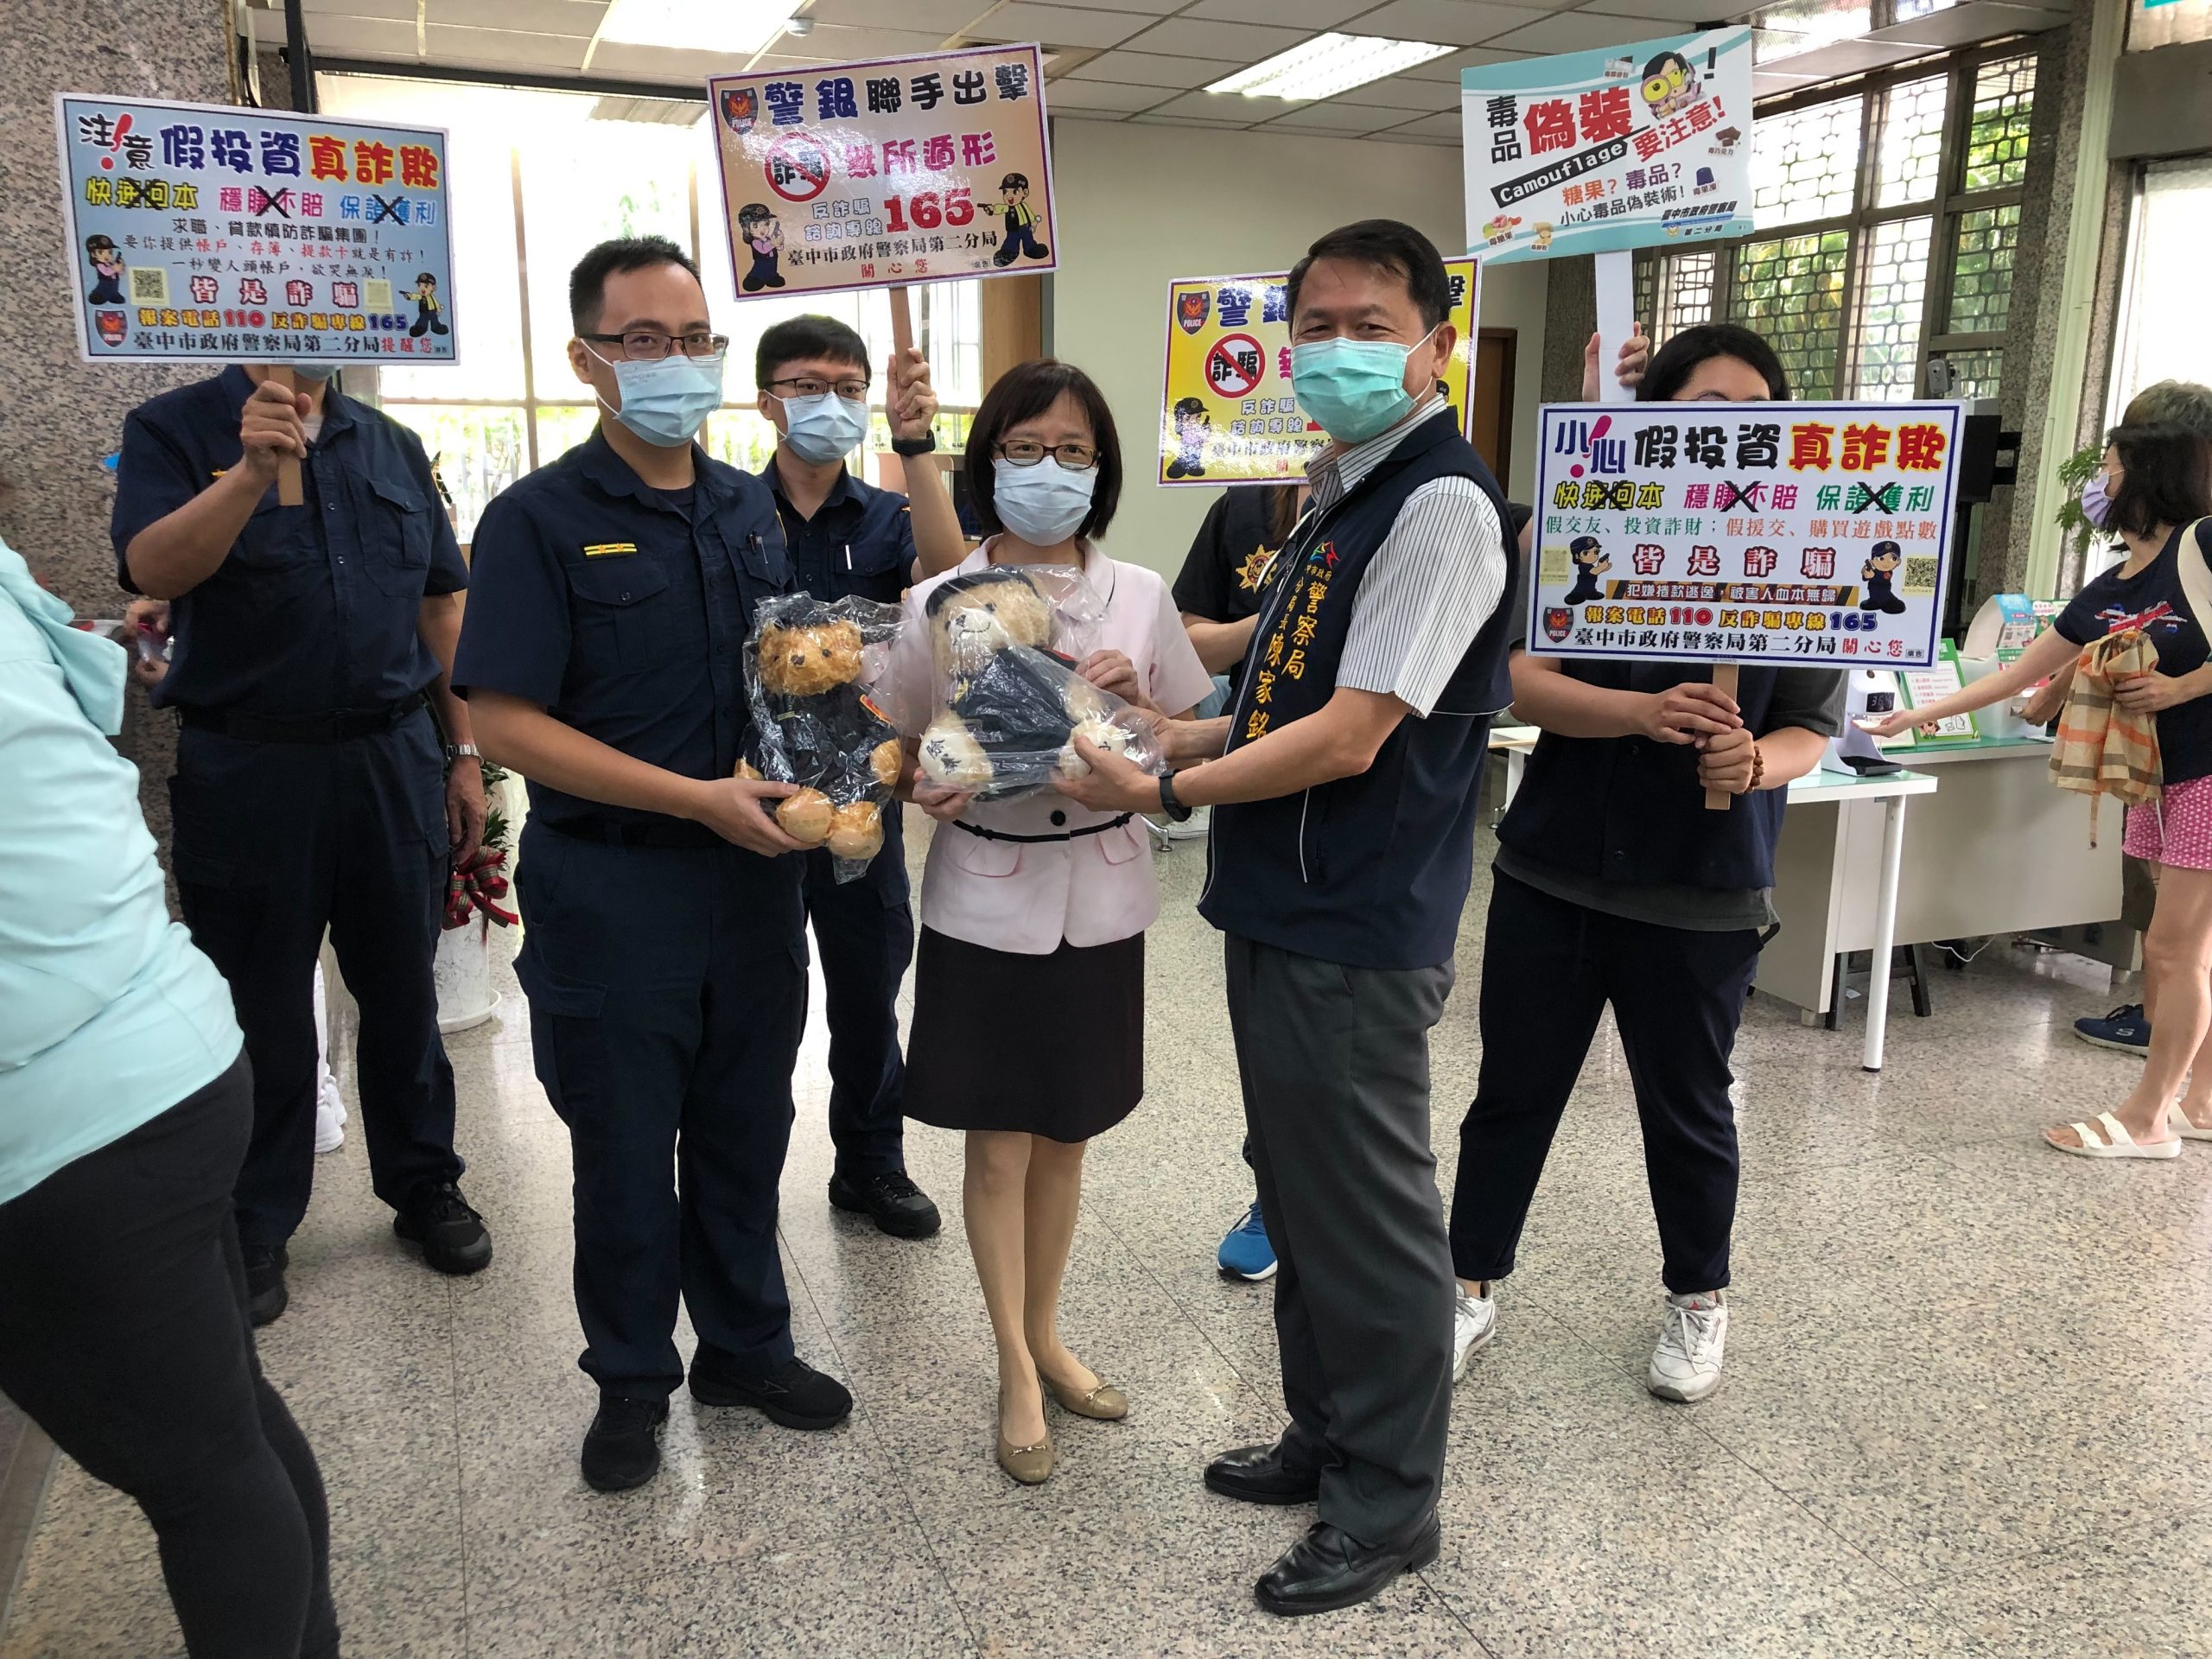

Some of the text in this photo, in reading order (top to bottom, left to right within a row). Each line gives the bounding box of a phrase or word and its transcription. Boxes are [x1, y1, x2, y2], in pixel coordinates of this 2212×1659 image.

[1486, 95, 1522, 163] 毒品
[1523, 86, 1633, 156] 偽裝
[1631, 95, 1726, 162] 要注意！
[161, 124, 302, 177] 假投資
[308, 135, 439, 188] 真詐欺
[1499, 143, 1624, 202] Camouflage
[812, 198, 871, 219] 反詐騙
[884, 187, 974, 232] 165
[1560, 186, 1685, 227] 小心毒品偽裝術！
[787, 231, 997, 267] 臺中市政府警察局第二分局
[804, 218, 882, 241] 諮詢專線
[1183, 319, 1202, 327] POLICE
[1230, 416, 1303, 435] 諮詢專線
[1241, 397, 1294, 415] 反詐騙
[1635, 423, 1781, 470] 假投資
[1788, 422, 1946, 472] 真詐欺
[1281, 581, 1328, 680] 警察局
